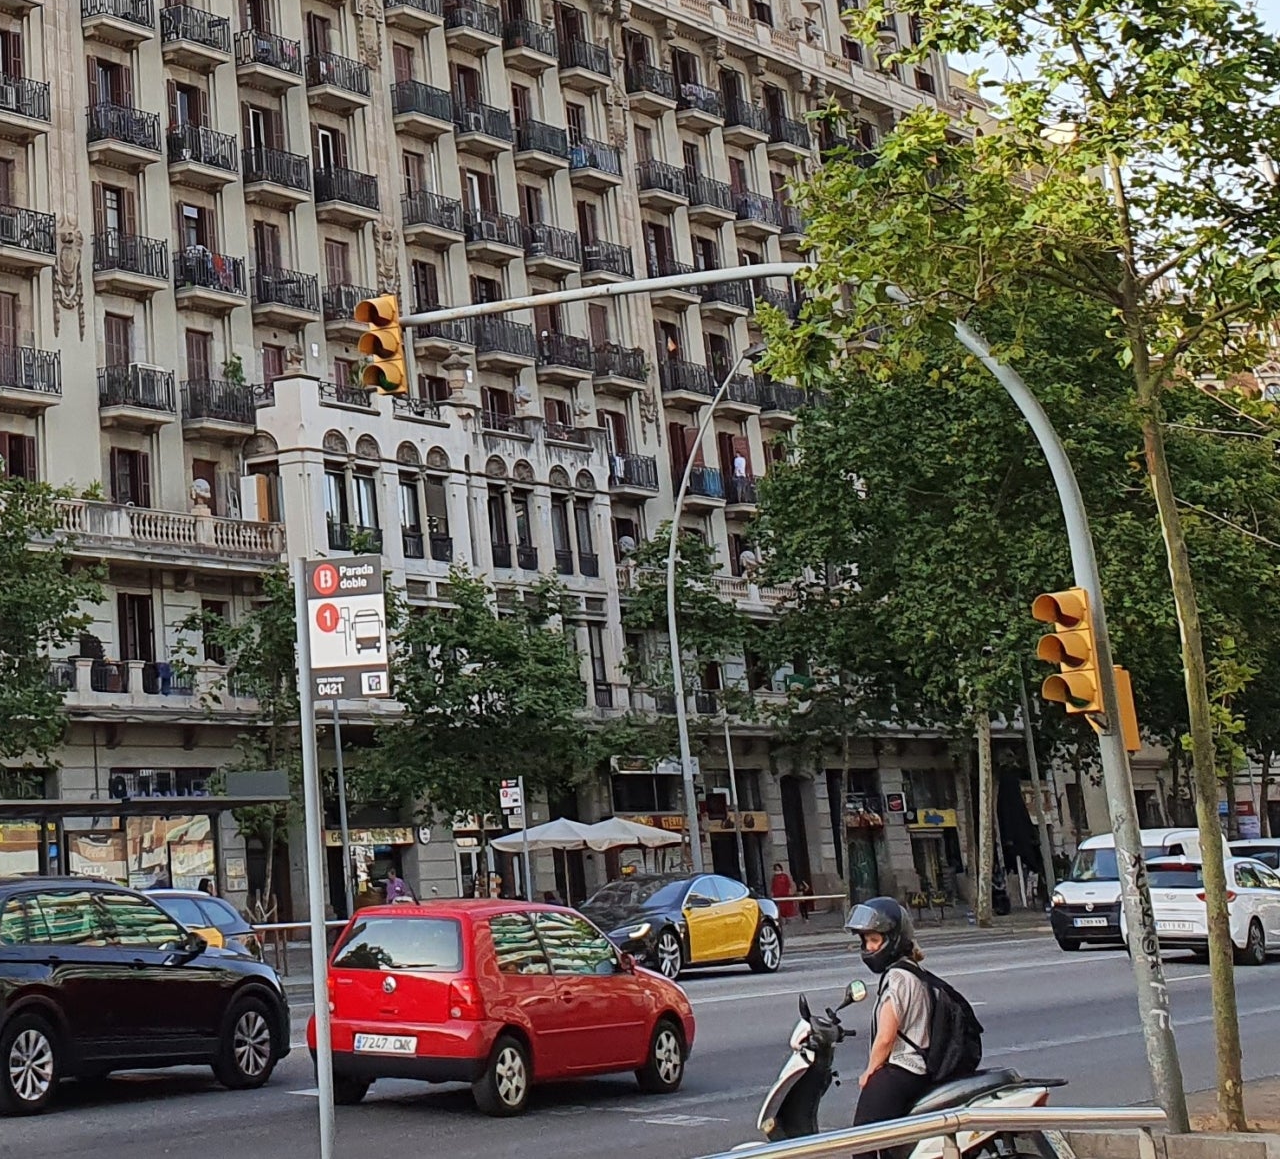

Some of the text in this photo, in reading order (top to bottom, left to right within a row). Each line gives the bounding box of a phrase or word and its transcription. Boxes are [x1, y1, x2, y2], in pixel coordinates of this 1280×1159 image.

[339, 564, 374, 577] Parada
[319, 569, 333, 589] B
[339, 577, 368, 589] doble
[318, 683, 343, 696] 0421
[361, 1036, 388, 1049] 7247
